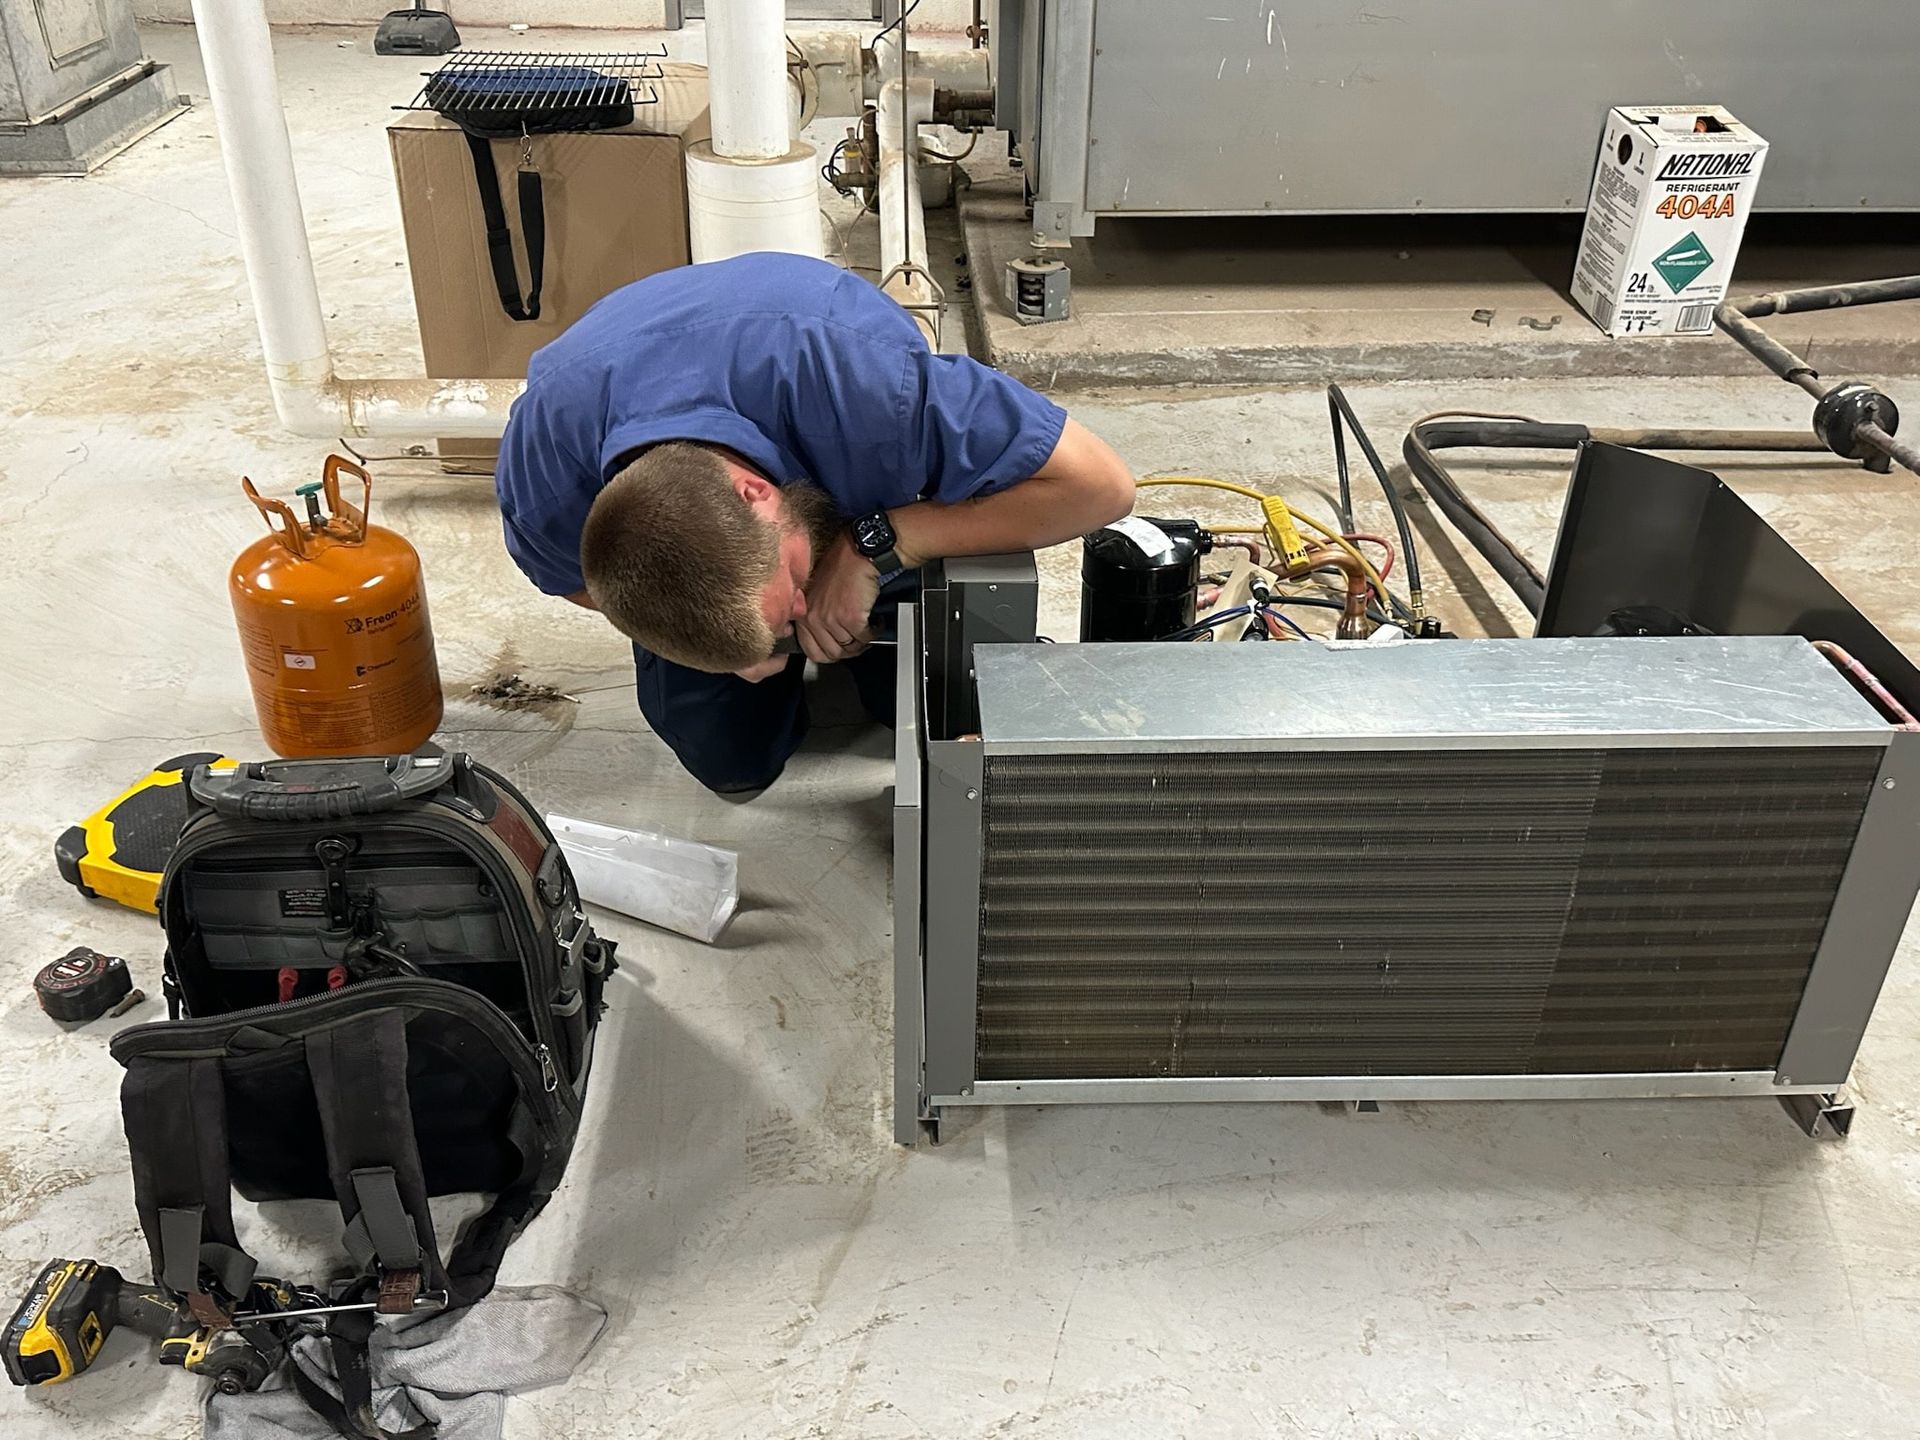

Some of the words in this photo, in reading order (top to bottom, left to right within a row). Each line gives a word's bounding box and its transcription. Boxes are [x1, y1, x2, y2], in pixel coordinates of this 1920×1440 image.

[1655, 152, 1757, 181] NATIONAL
[1666, 182, 1740, 193] REFRIGERANT
[1656, 194, 1734, 219] 404A
[1627, 273, 1648, 293] 24
